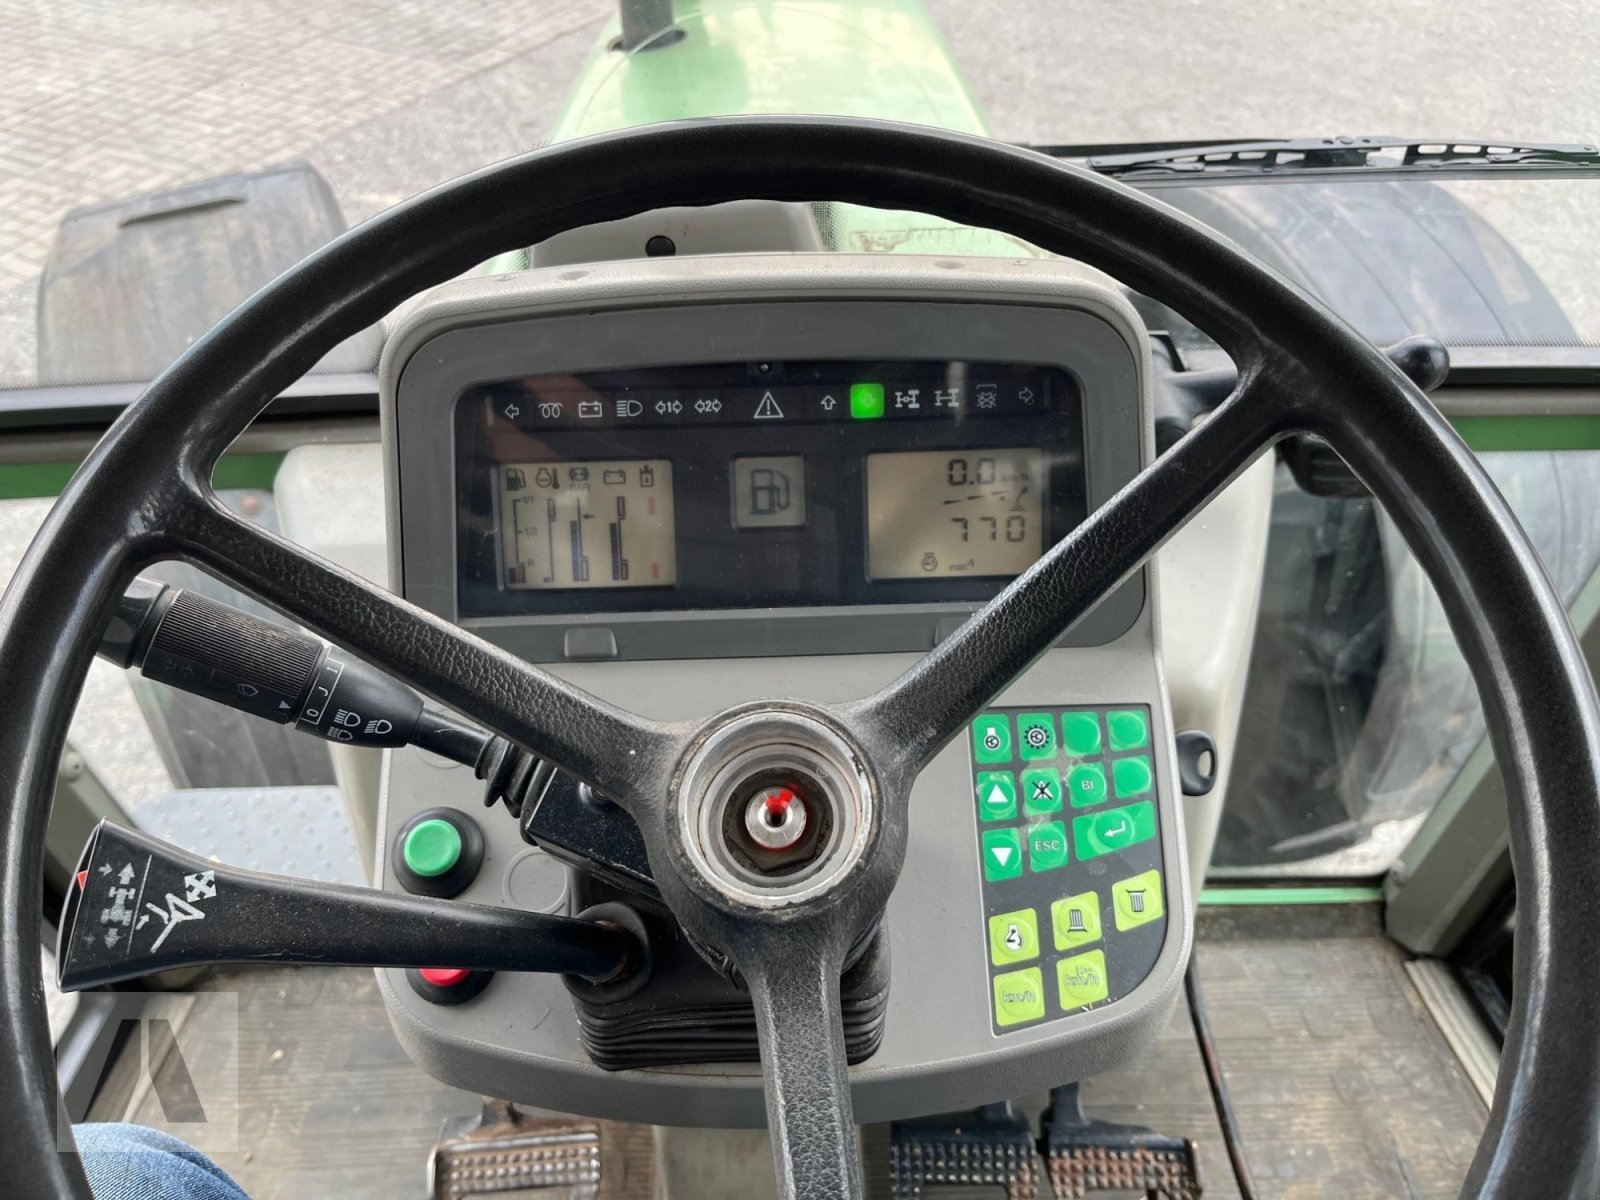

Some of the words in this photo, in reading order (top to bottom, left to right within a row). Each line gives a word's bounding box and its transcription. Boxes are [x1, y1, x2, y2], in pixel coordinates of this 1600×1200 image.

[705, 401, 712, 411] 2
[948, 457, 995, 486] 0.0
[952, 516, 1025, 542] 770
[1034, 840, 1060, 851] ESC
